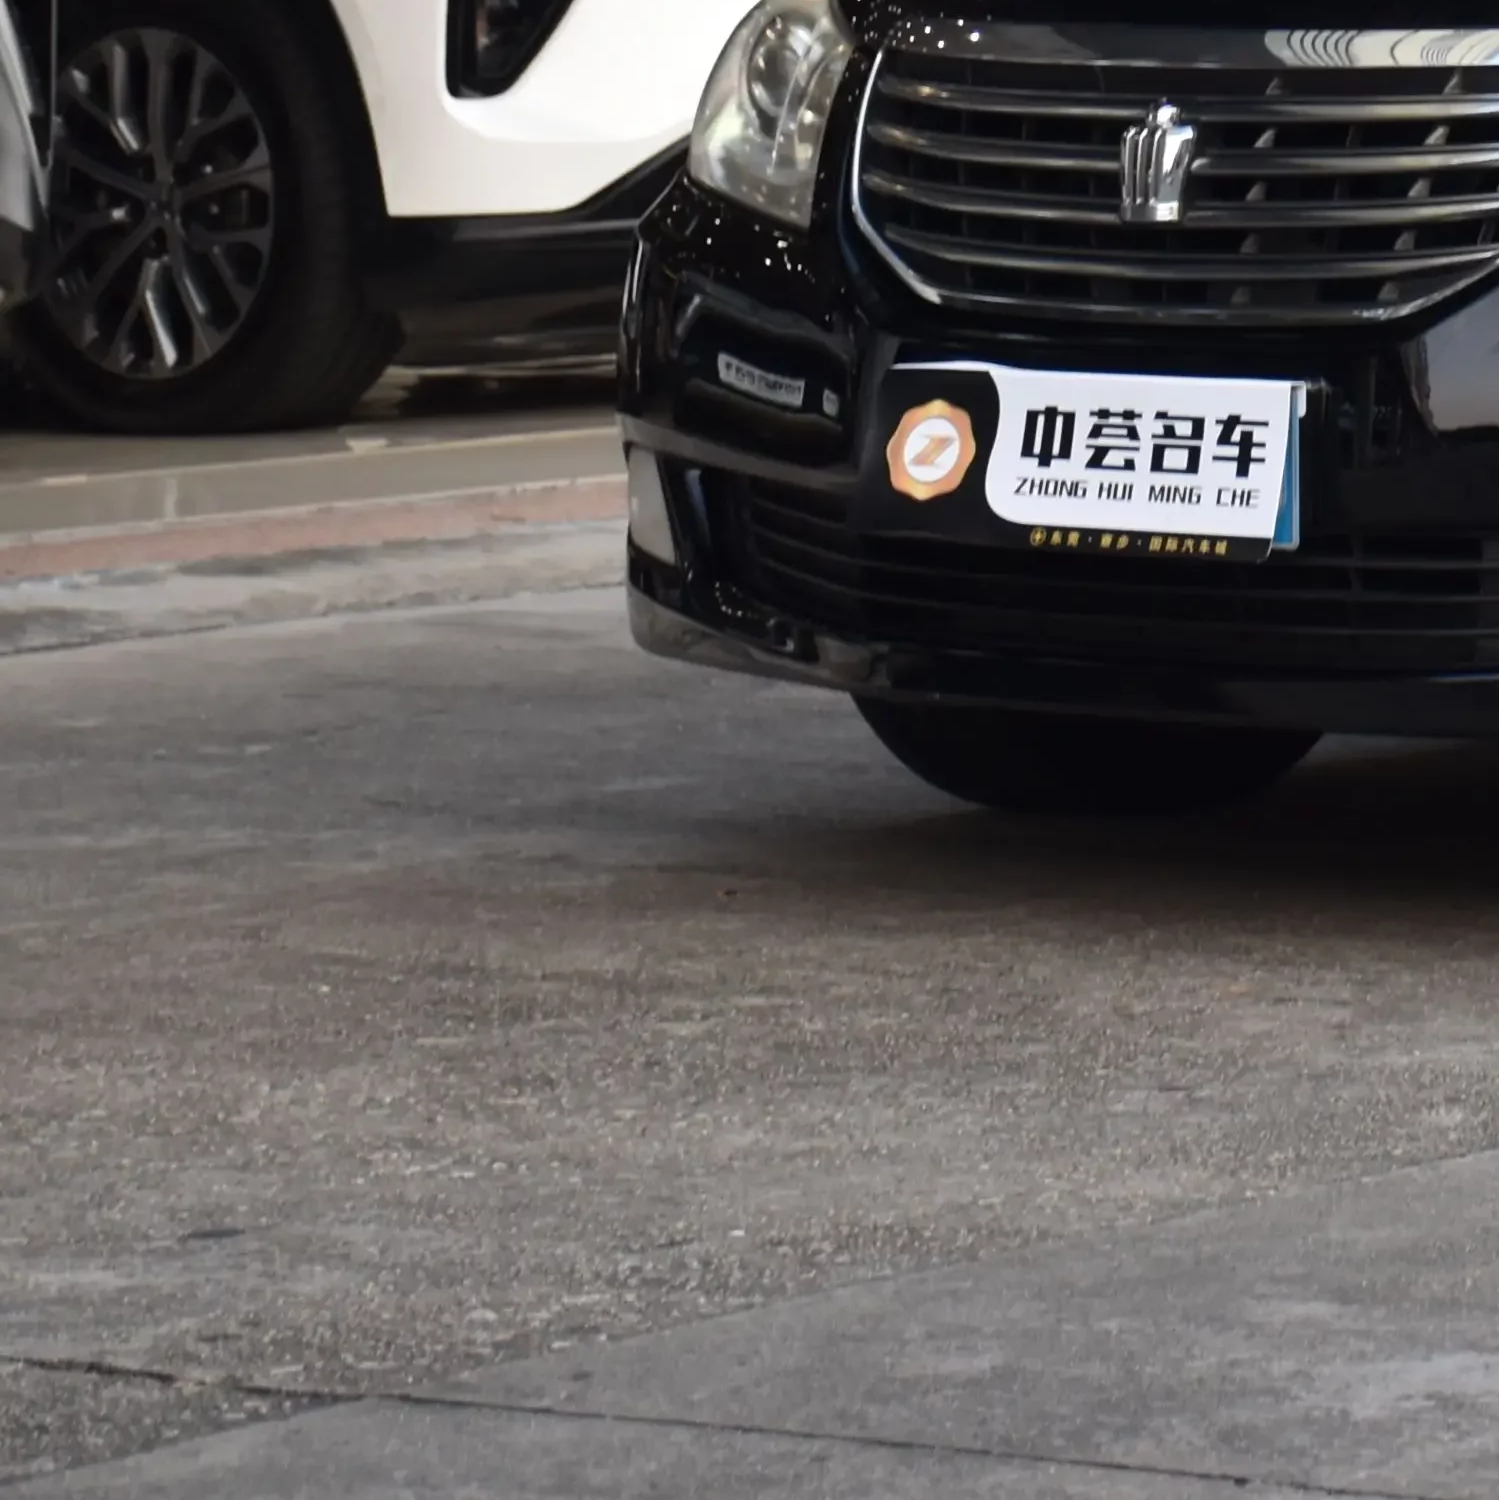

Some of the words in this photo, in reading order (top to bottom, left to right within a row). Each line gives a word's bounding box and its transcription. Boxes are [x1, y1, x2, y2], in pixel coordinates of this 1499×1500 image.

[1019, 405, 1270, 478] 中荟名车
[1013, 476, 1088, 500] ZHONG
[1098, 481, 1134, 502] HUI
[1148, 485, 1203, 506] MING
[1215, 488, 1260, 510] CHE
